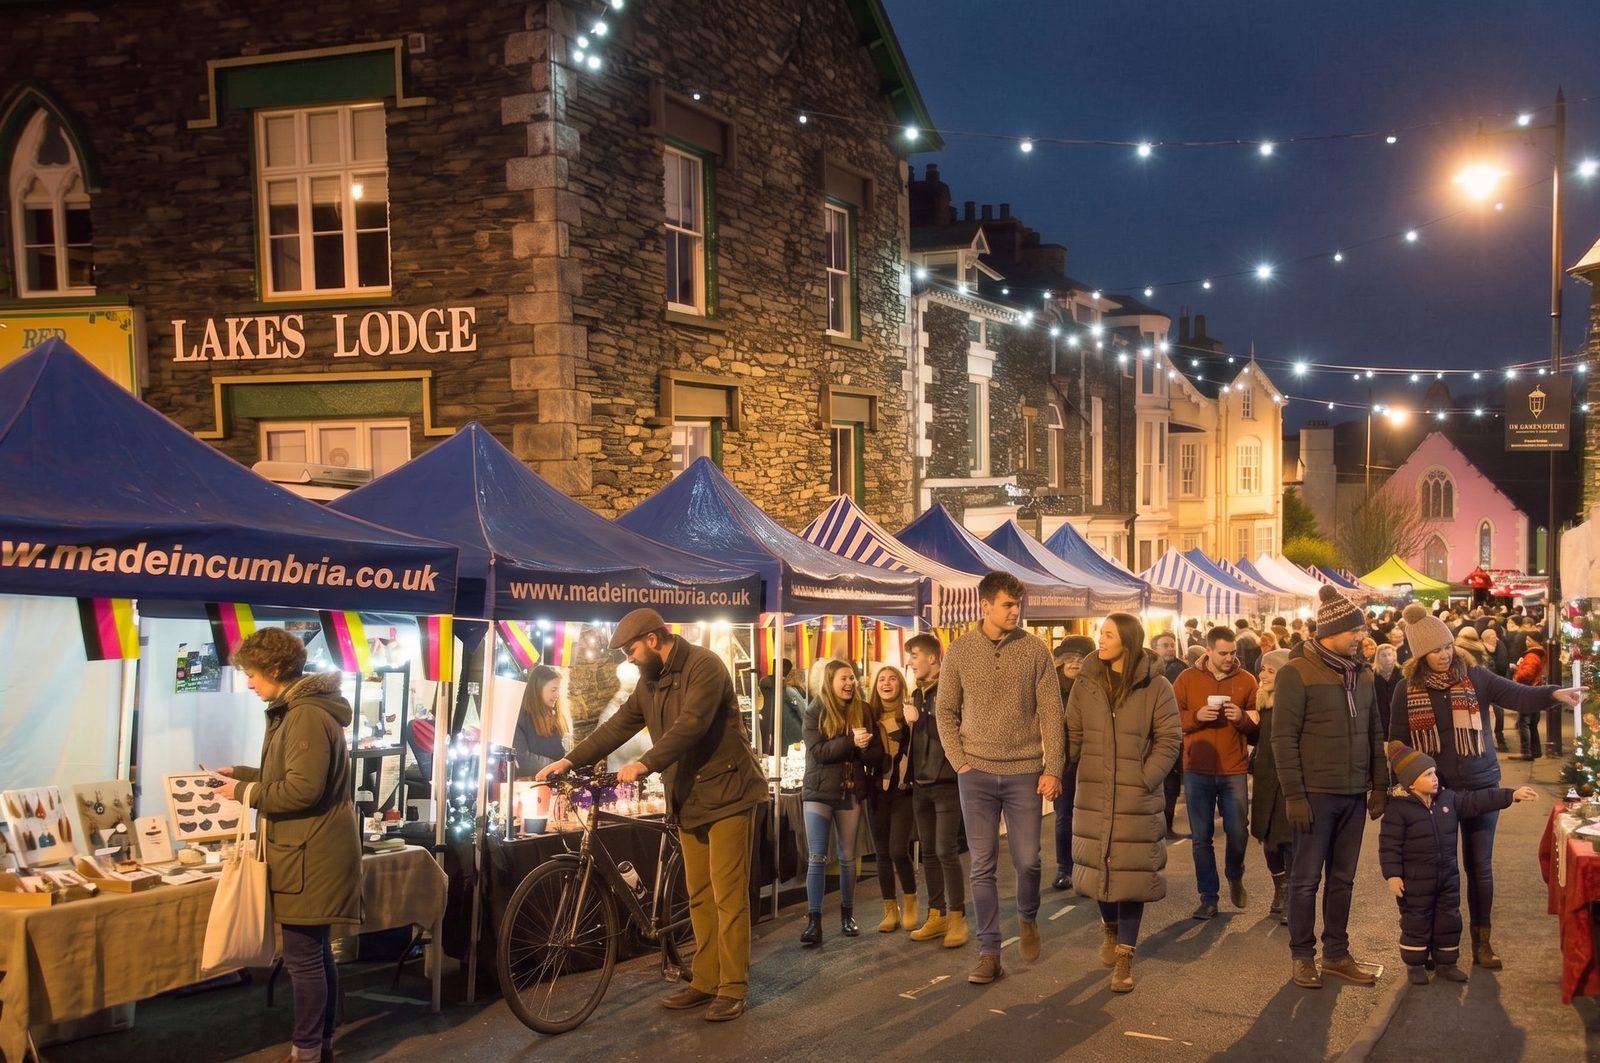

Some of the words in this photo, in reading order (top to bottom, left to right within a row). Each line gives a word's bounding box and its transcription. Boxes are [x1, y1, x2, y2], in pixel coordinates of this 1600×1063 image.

[171, 314, 306, 362] LAKES
[333, 306, 477, 357] LODGE
[1, 541, 440, 592] w.madeincumbria.co.uk
[510, 582, 750, 606] www.madeincumbria.co.uk
